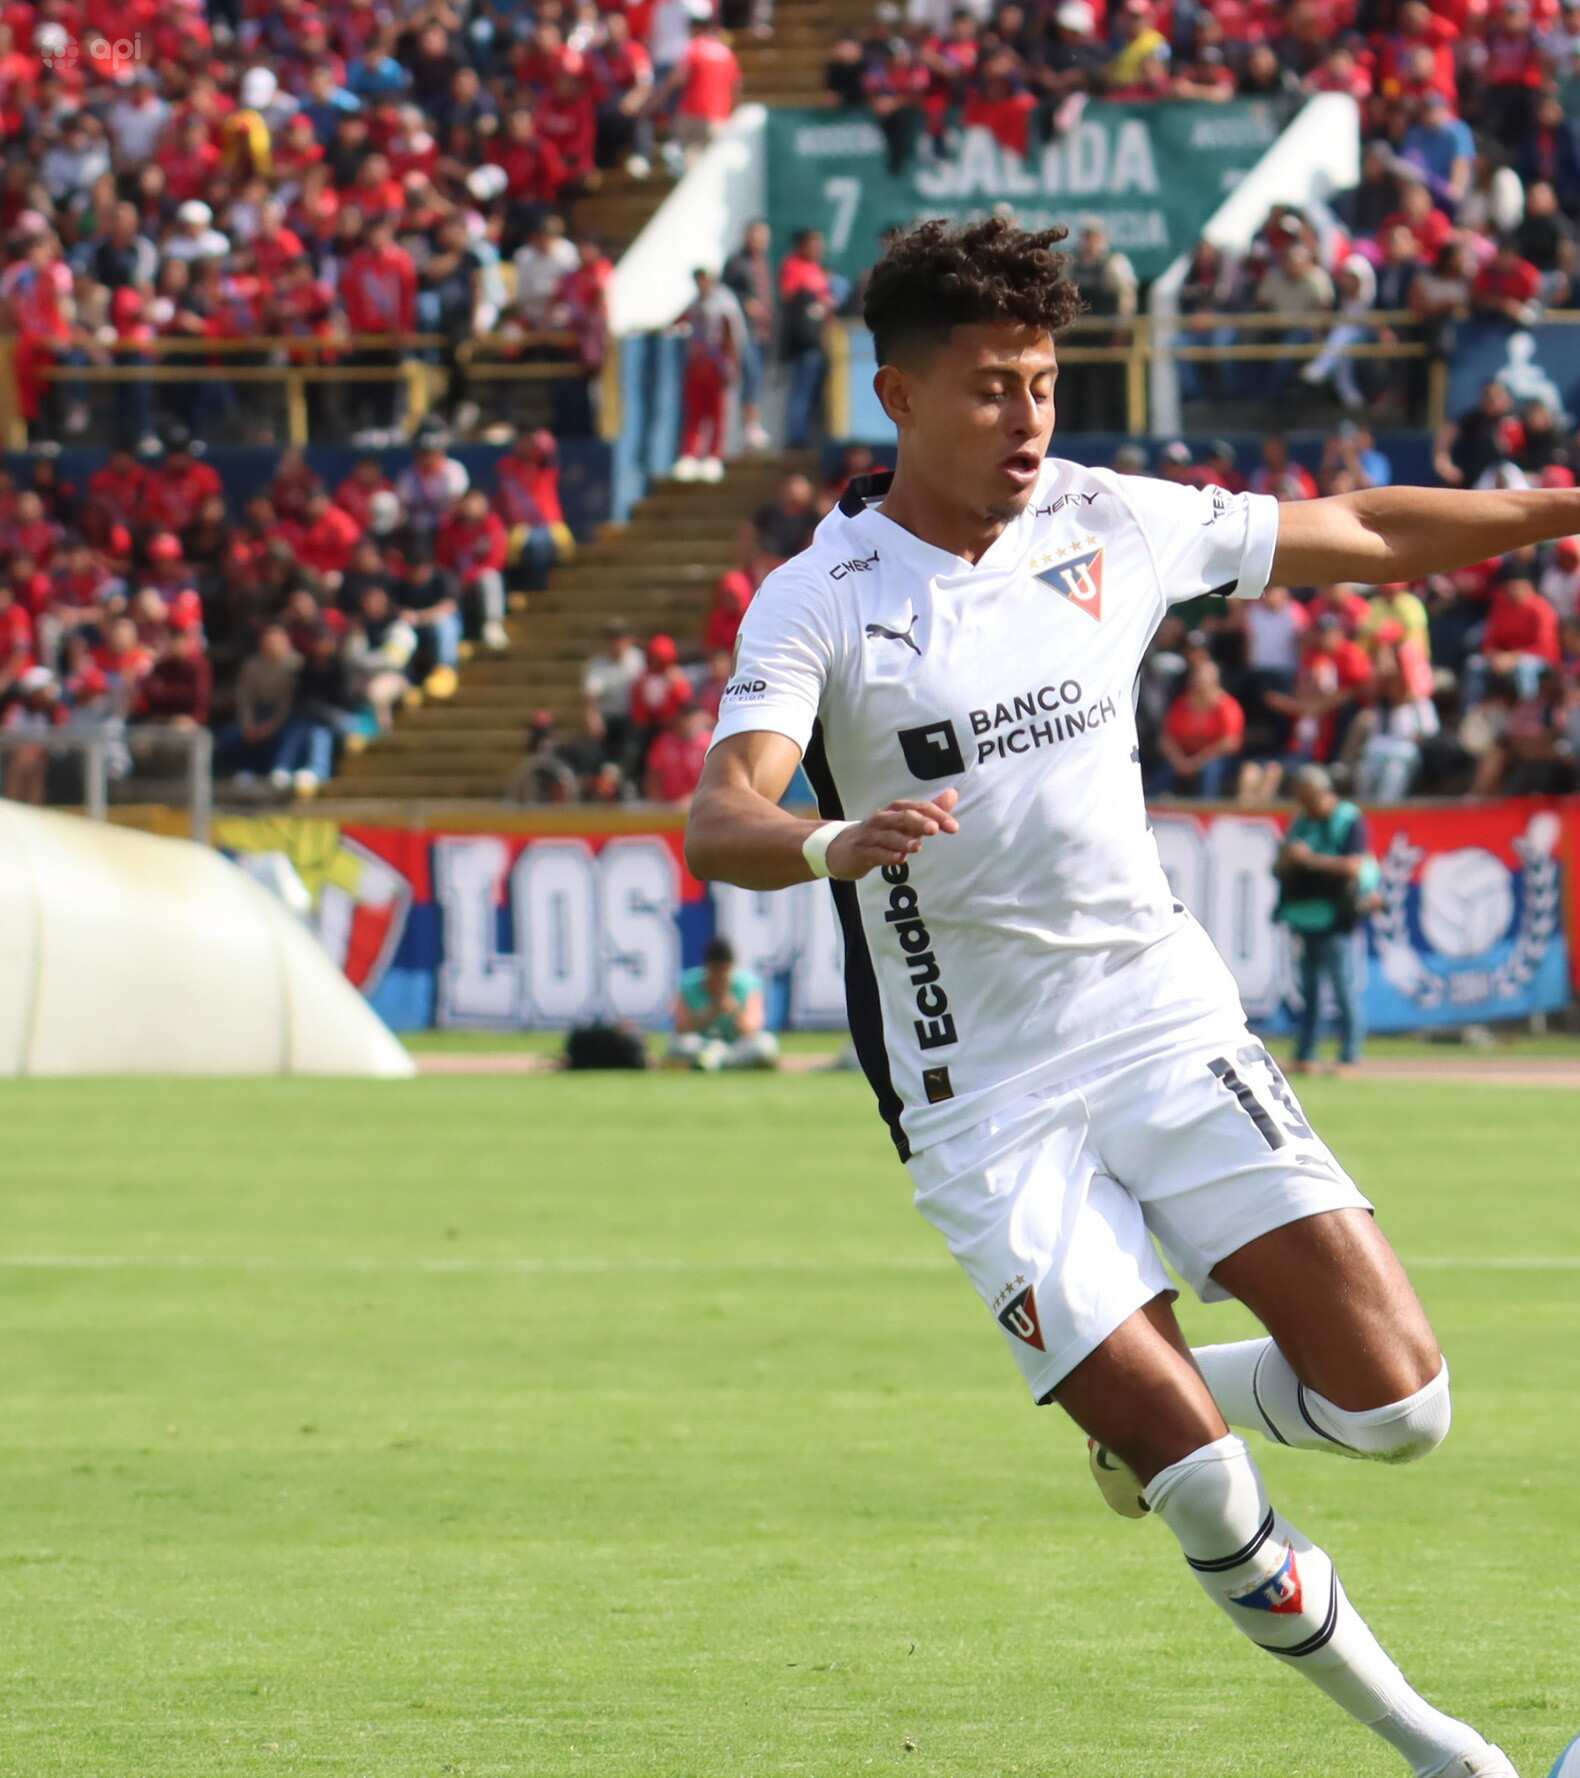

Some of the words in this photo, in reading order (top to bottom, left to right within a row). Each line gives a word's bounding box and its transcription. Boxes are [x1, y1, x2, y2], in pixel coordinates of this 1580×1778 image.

[913, 119, 1159, 197] SALIDA
[825, 177, 861, 253] 7
[829, 549, 881, 580] CHERY
[969, 679, 1082, 736] BANCO
[977, 692, 1121, 764] PICHINCH
[435, 834, 682, 1029] LOS
